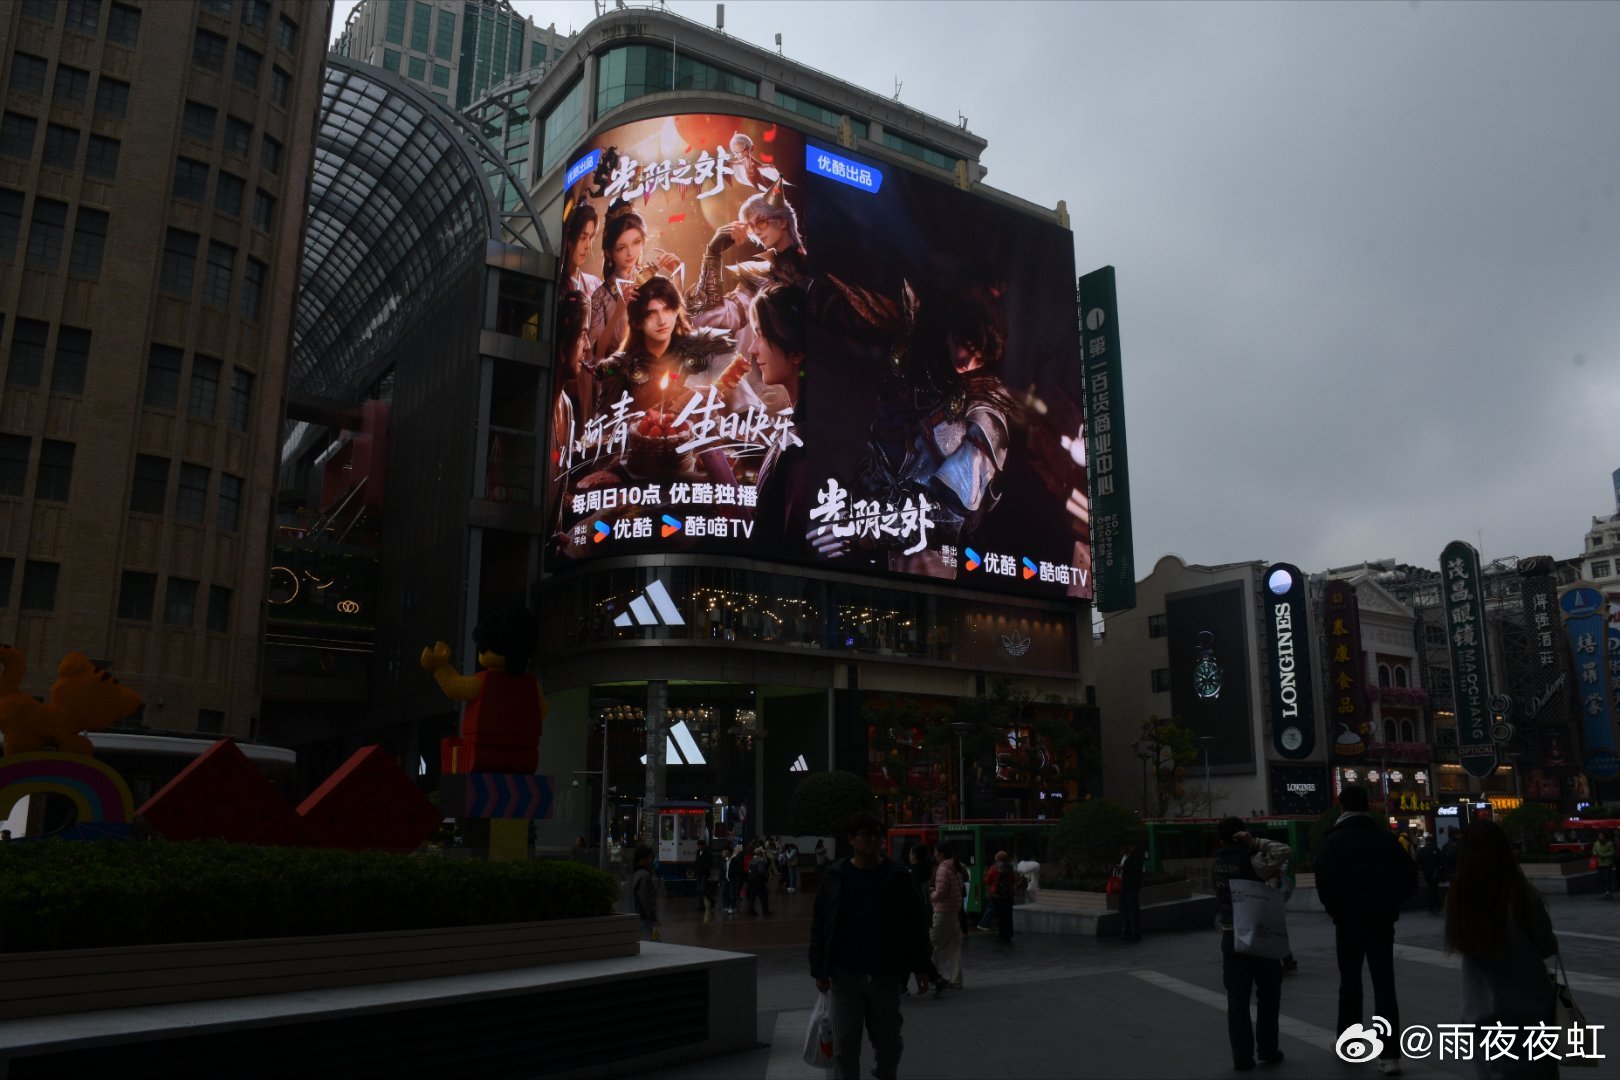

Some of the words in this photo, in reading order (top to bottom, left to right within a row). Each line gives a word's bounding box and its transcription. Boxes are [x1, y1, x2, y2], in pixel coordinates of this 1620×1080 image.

[567, 155, 594, 185] 优酷出品
[604, 145, 733, 207] 光阴之外
[817, 154, 873, 187] 优酷出品
[671, 384, 804, 454] 生日快乐
[1089, 336, 1115, 497] 第一百货商业中心
[572, 484, 661, 514] 每周日10点
[669, 482, 758, 507] 优酷独播
[612, 517, 653, 540] 优酷
[684, 516, 754, 539] 酷喵TV
[810, 478, 935, 556] 光阴之外
[942, 556, 957, 568] 平台
[983, 552, 1017, 577] 优酷
[1039, 561, 1088, 588] 酷喵TV
[1447, 557, 1478, 648] 茂昌眼镜
[1275, 602, 1298, 719] LONGINES
[1286, 783, 1316, 792] LONGINES
